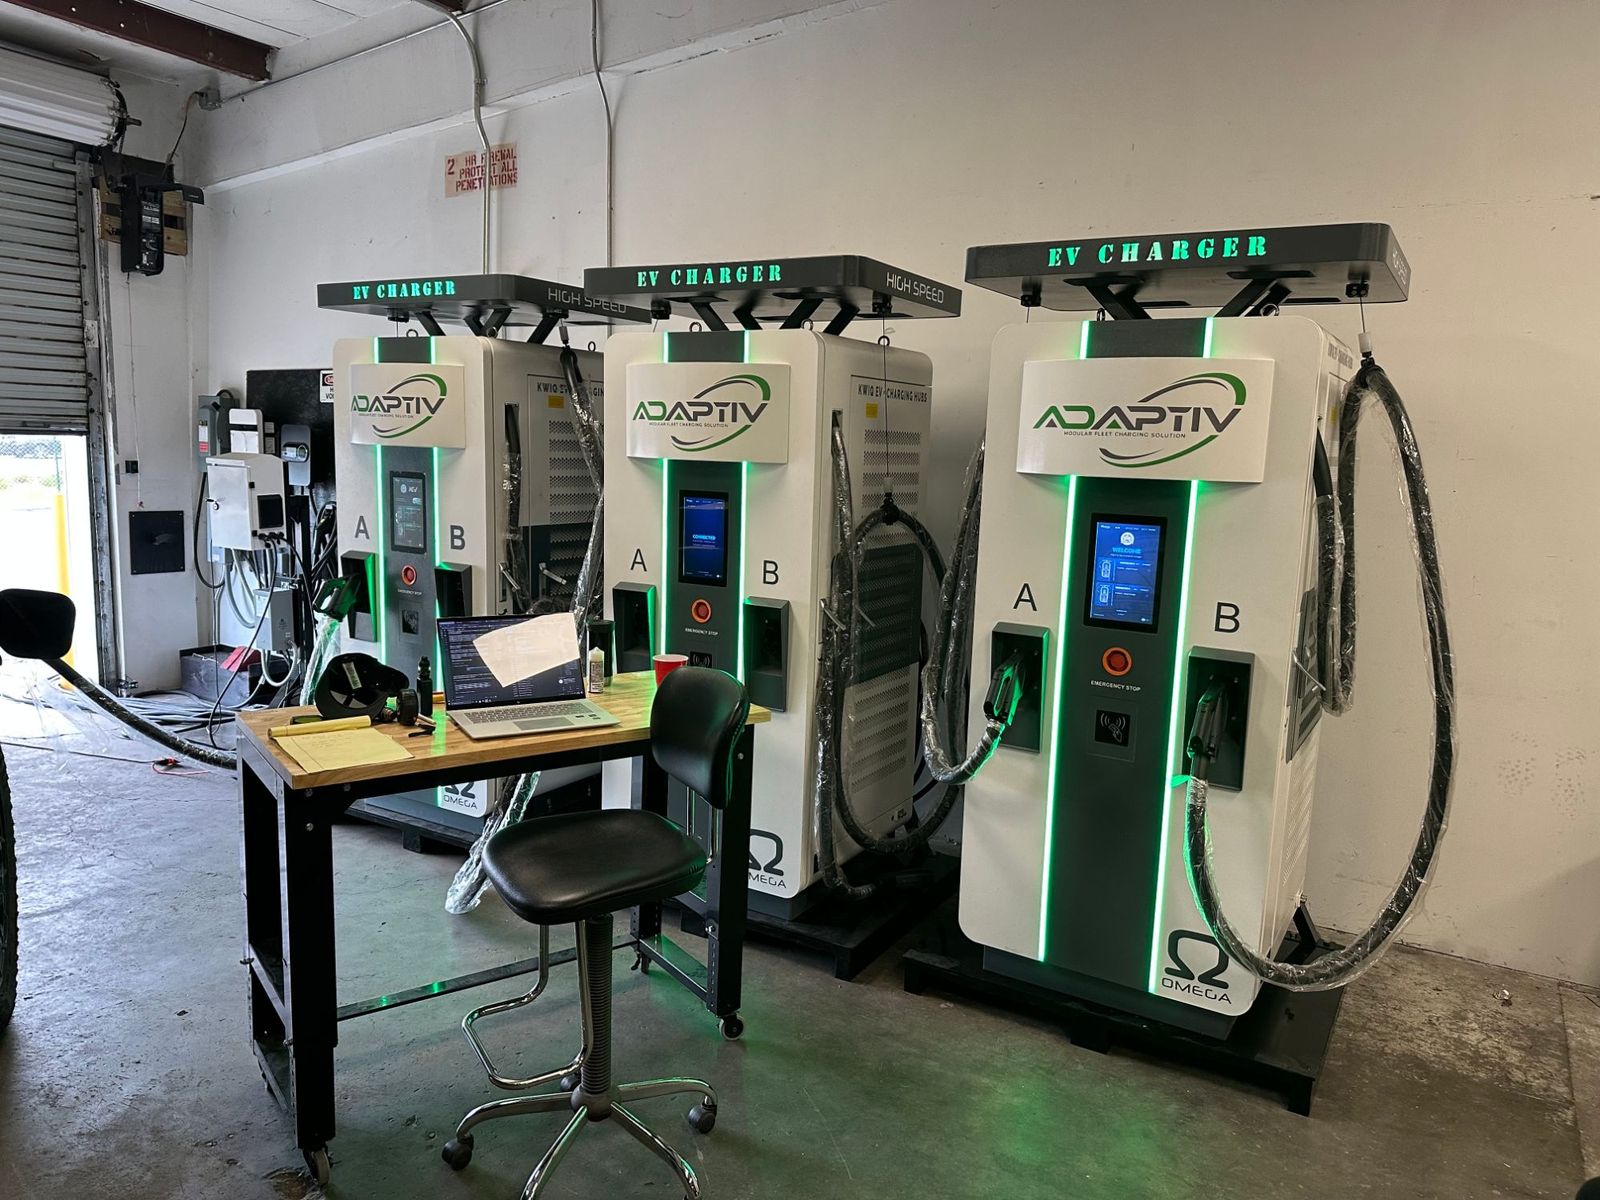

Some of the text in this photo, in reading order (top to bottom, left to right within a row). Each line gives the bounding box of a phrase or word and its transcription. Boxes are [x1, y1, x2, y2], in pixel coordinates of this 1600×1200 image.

[447, 148, 517, 175] 2 HR FREWAL
[460, 163, 497, 179] PROTET
[456, 172, 518, 192] PENETATIONS
[1048, 236, 1267, 267] EV CHARGER
[637, 264, 781, 287] EV CHARGER
[886, 272, 944, 303] HIGH SPEED
[353, 280, 456, 300] EV CHARGER
[548, 287, 627, 313] HIGH SPEED
[858, 383, 874, 397] KWIQ
[351, 395, 446, 415] ADAPTIV
[633, 401, 768, 423] ADAPTIV
[1033, 405, 1241, 433] ADAPTIV
[355, 515, 370, 540] A
[450, 525, 466, 550] B
[630, 548, 647, 572] A
[762, 560, 779, 585] B
[1013, 583, 1038, 612] A
[1214, 602, 1240, 633] B
[1090, 679, 1125, 690] EMERGENCY
[443, 794, 478, 810] OMEGA
[748, 871, 787, 889] MEGA
[1161, 977, 1232, 1005] OMEGA
